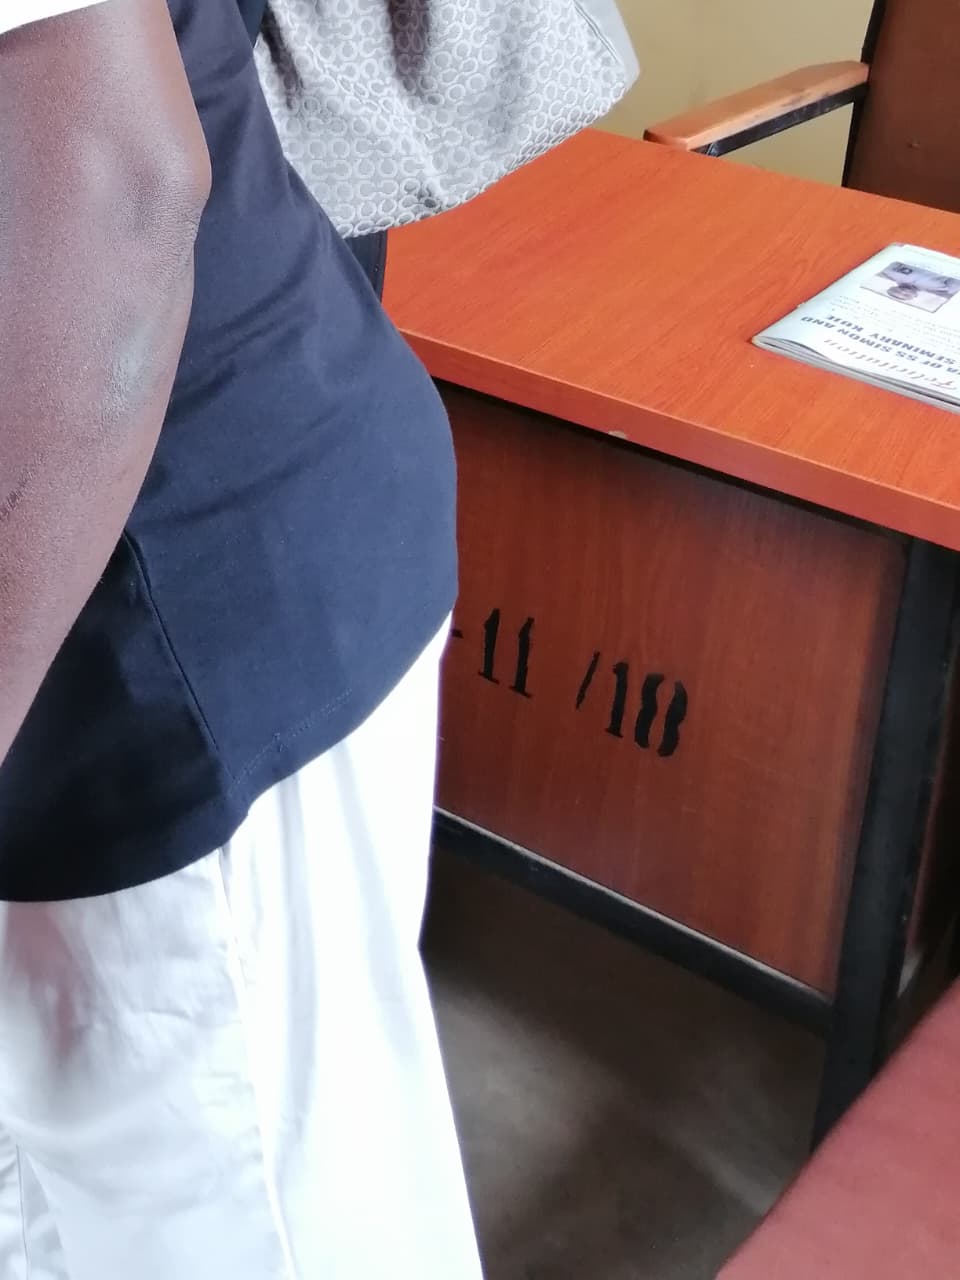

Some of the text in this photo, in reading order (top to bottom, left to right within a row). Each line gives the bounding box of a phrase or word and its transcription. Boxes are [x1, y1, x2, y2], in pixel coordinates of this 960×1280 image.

[801, 316, 835, 329] AND
[837, 328, 892, 353] SIMON
[869, 333, 956, 365] SEMINARY
